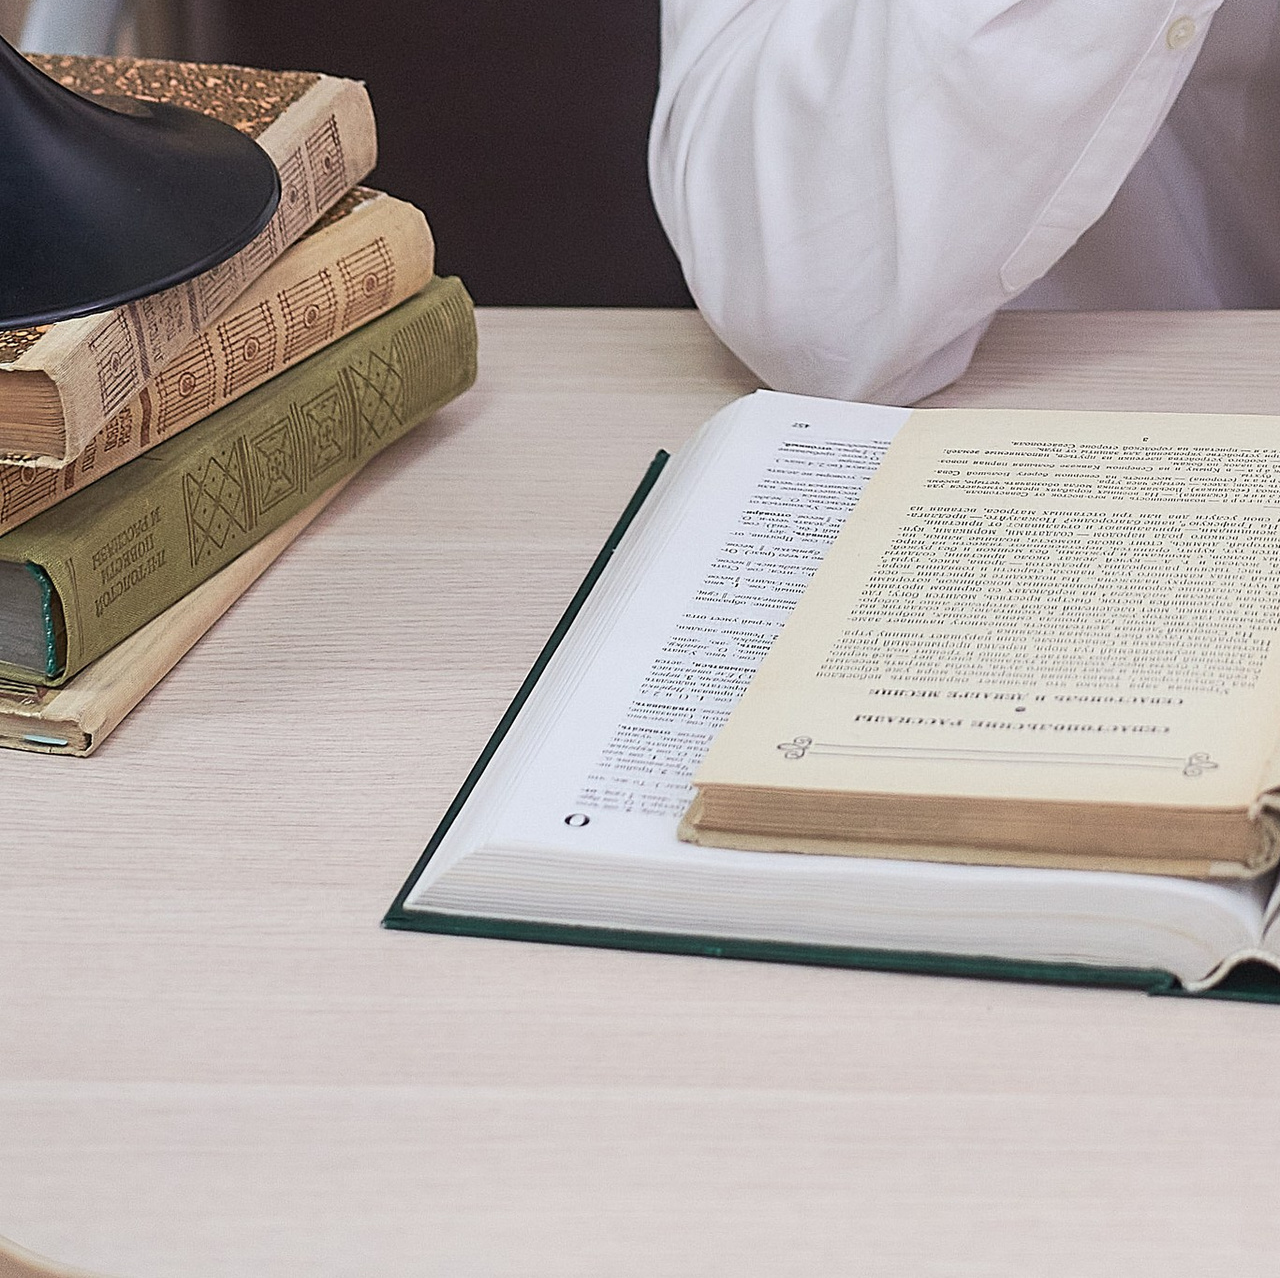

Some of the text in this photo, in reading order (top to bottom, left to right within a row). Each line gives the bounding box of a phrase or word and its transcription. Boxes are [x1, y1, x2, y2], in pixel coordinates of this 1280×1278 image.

[962, 490, 1030, 498] Севастополя.
[923, 519, 985, 527] пристани.
[931, 527, 998, 535] моряками,
[1185, 527, 1278, 536] женщинами,—
[922, 533, 964, 541] ялики,
[91, 515, 149, 570] РАССКАЗЫ
[888, 544, 934, 552] ружей,
[1054, 549, 1116, 557] ружьями,
[100, 533, 155, 585] ПОВЕСТИ
[915, 564, 976, 572] говядины
[887, 591, 921, 599] богу;
[982, 594, 1042, 602] крестясь,
[1046, 597, 1093, 605] быстро
[1148, 600, 1234, 609] зардевшийся
[868, 687, 942, 698] МЕСЯЦЕ
[946, 690, 1029, 702] ДЕКАБРЕ
[1053, 694, 1184, 705] СЕВАСТОПОЛЬ
[853, 714, 1170, 734] СЕВАСТОПОЛЬСКИЕ РАССКАЗЫ
[564, 813, 590, 828] О
